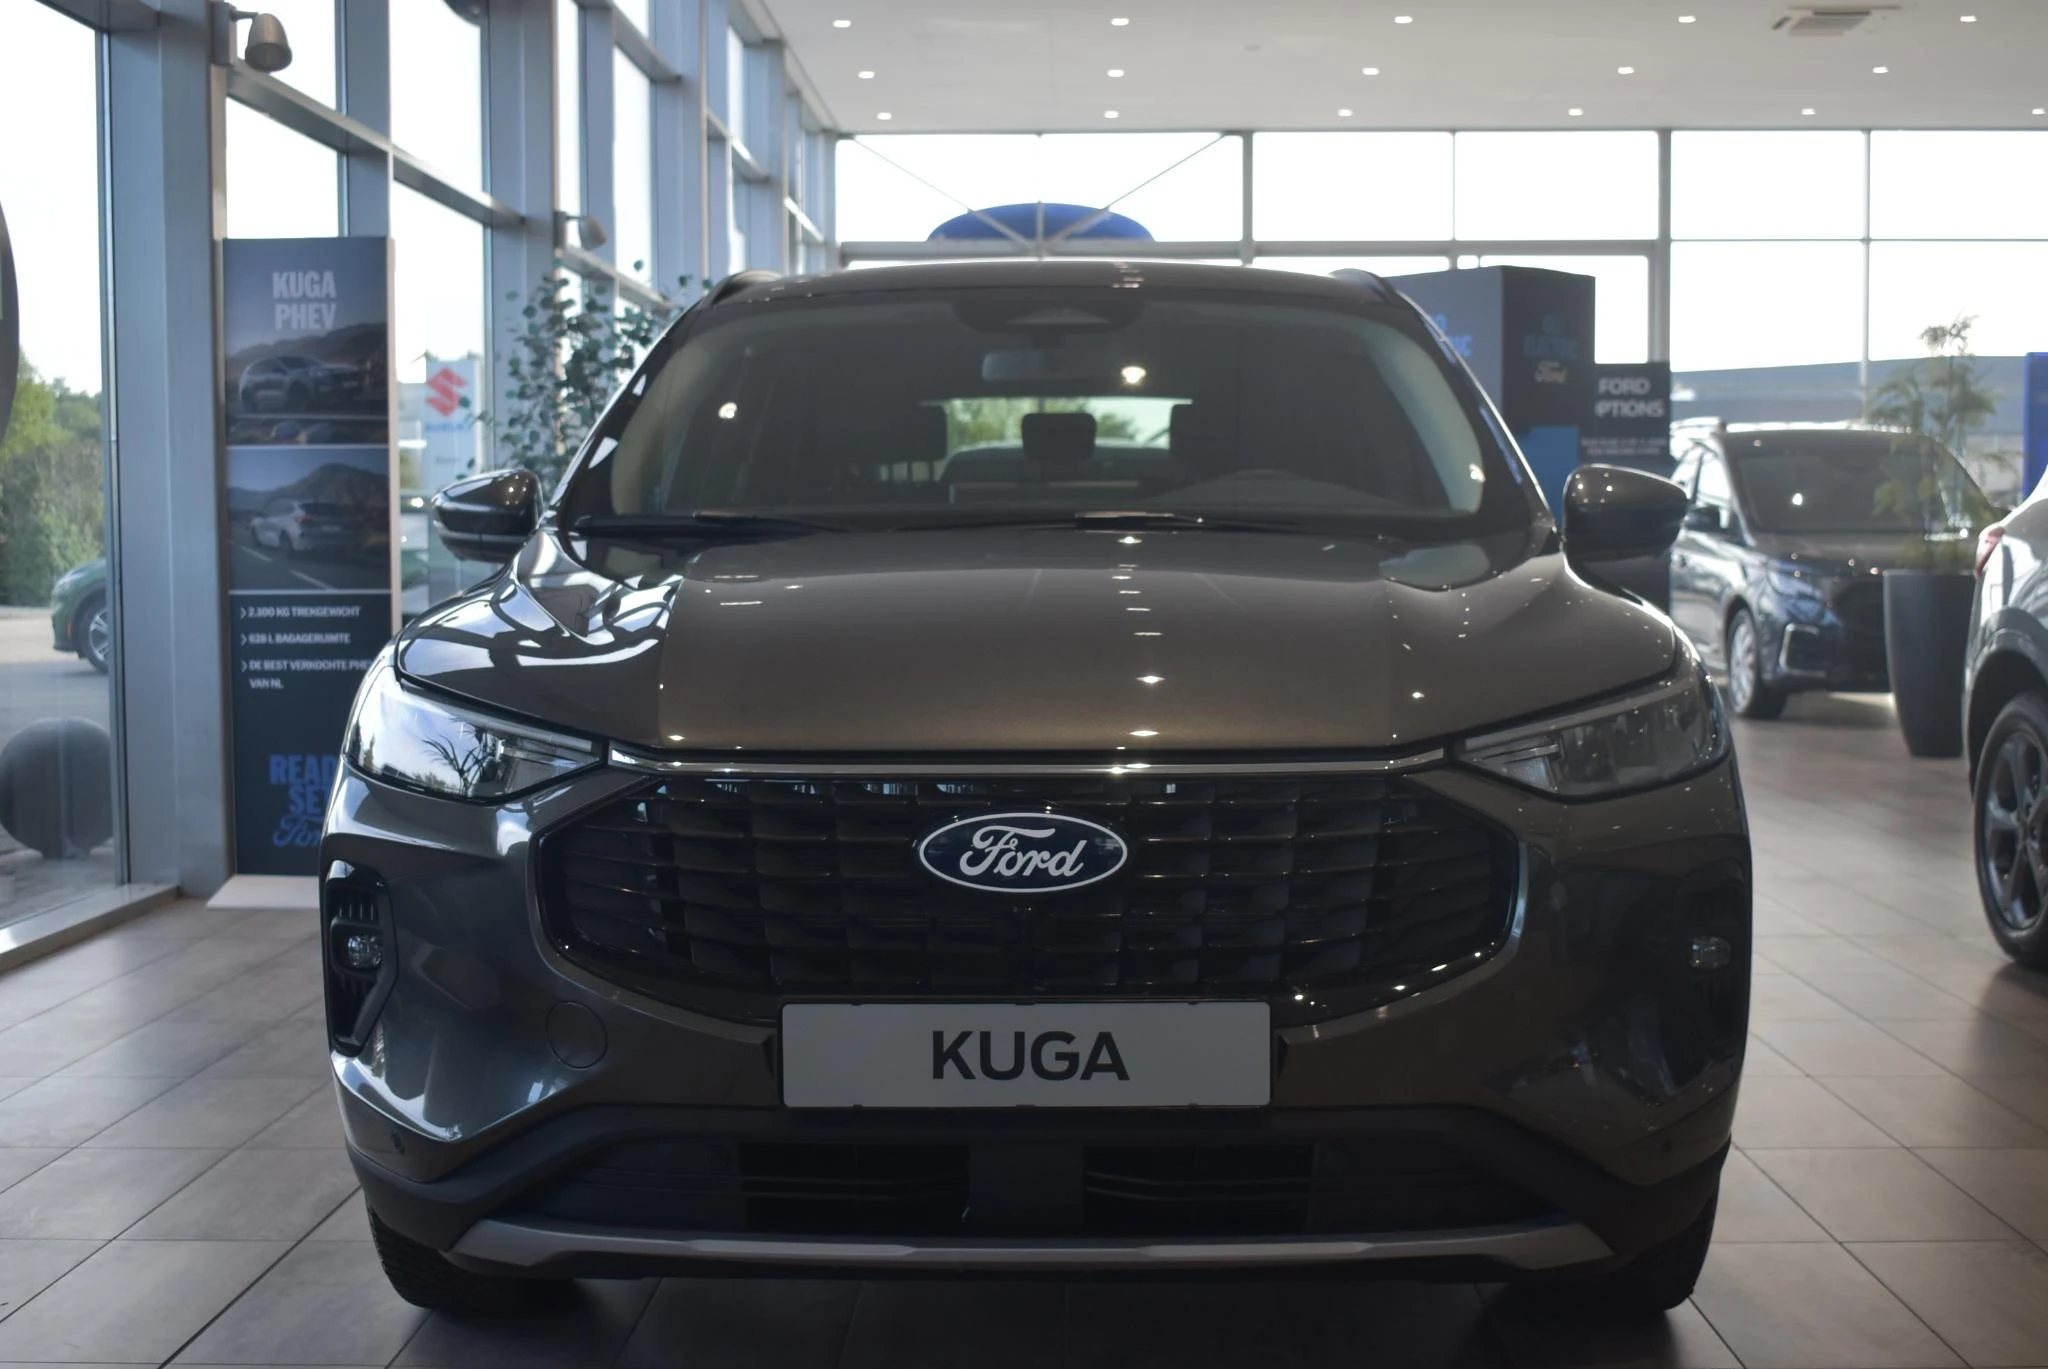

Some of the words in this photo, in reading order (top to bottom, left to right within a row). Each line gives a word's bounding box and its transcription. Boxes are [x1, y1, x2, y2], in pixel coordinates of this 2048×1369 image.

[272, 270, 337, 299] KUGA
[274, 302, 337, 330] PHEV
[1598, 376, 1651, 396] FORD
[276, 606, 290, 618] KG
[291, 605, 361, 618] TREKGEWICHT
[275, 632, 352, 645] BAGAGERUIMTE
[249, 659, 262, 671] DE
[263, 659, 288, 671] BEST
[289, 659, 348, 671] VERKOCHTE
[249, 678, 269, 689] VAN
[269, 754, 339, 785] READ
[958, 824, 1089, 877] Ford
[931, 1030, 1131, 1082] KUGA
